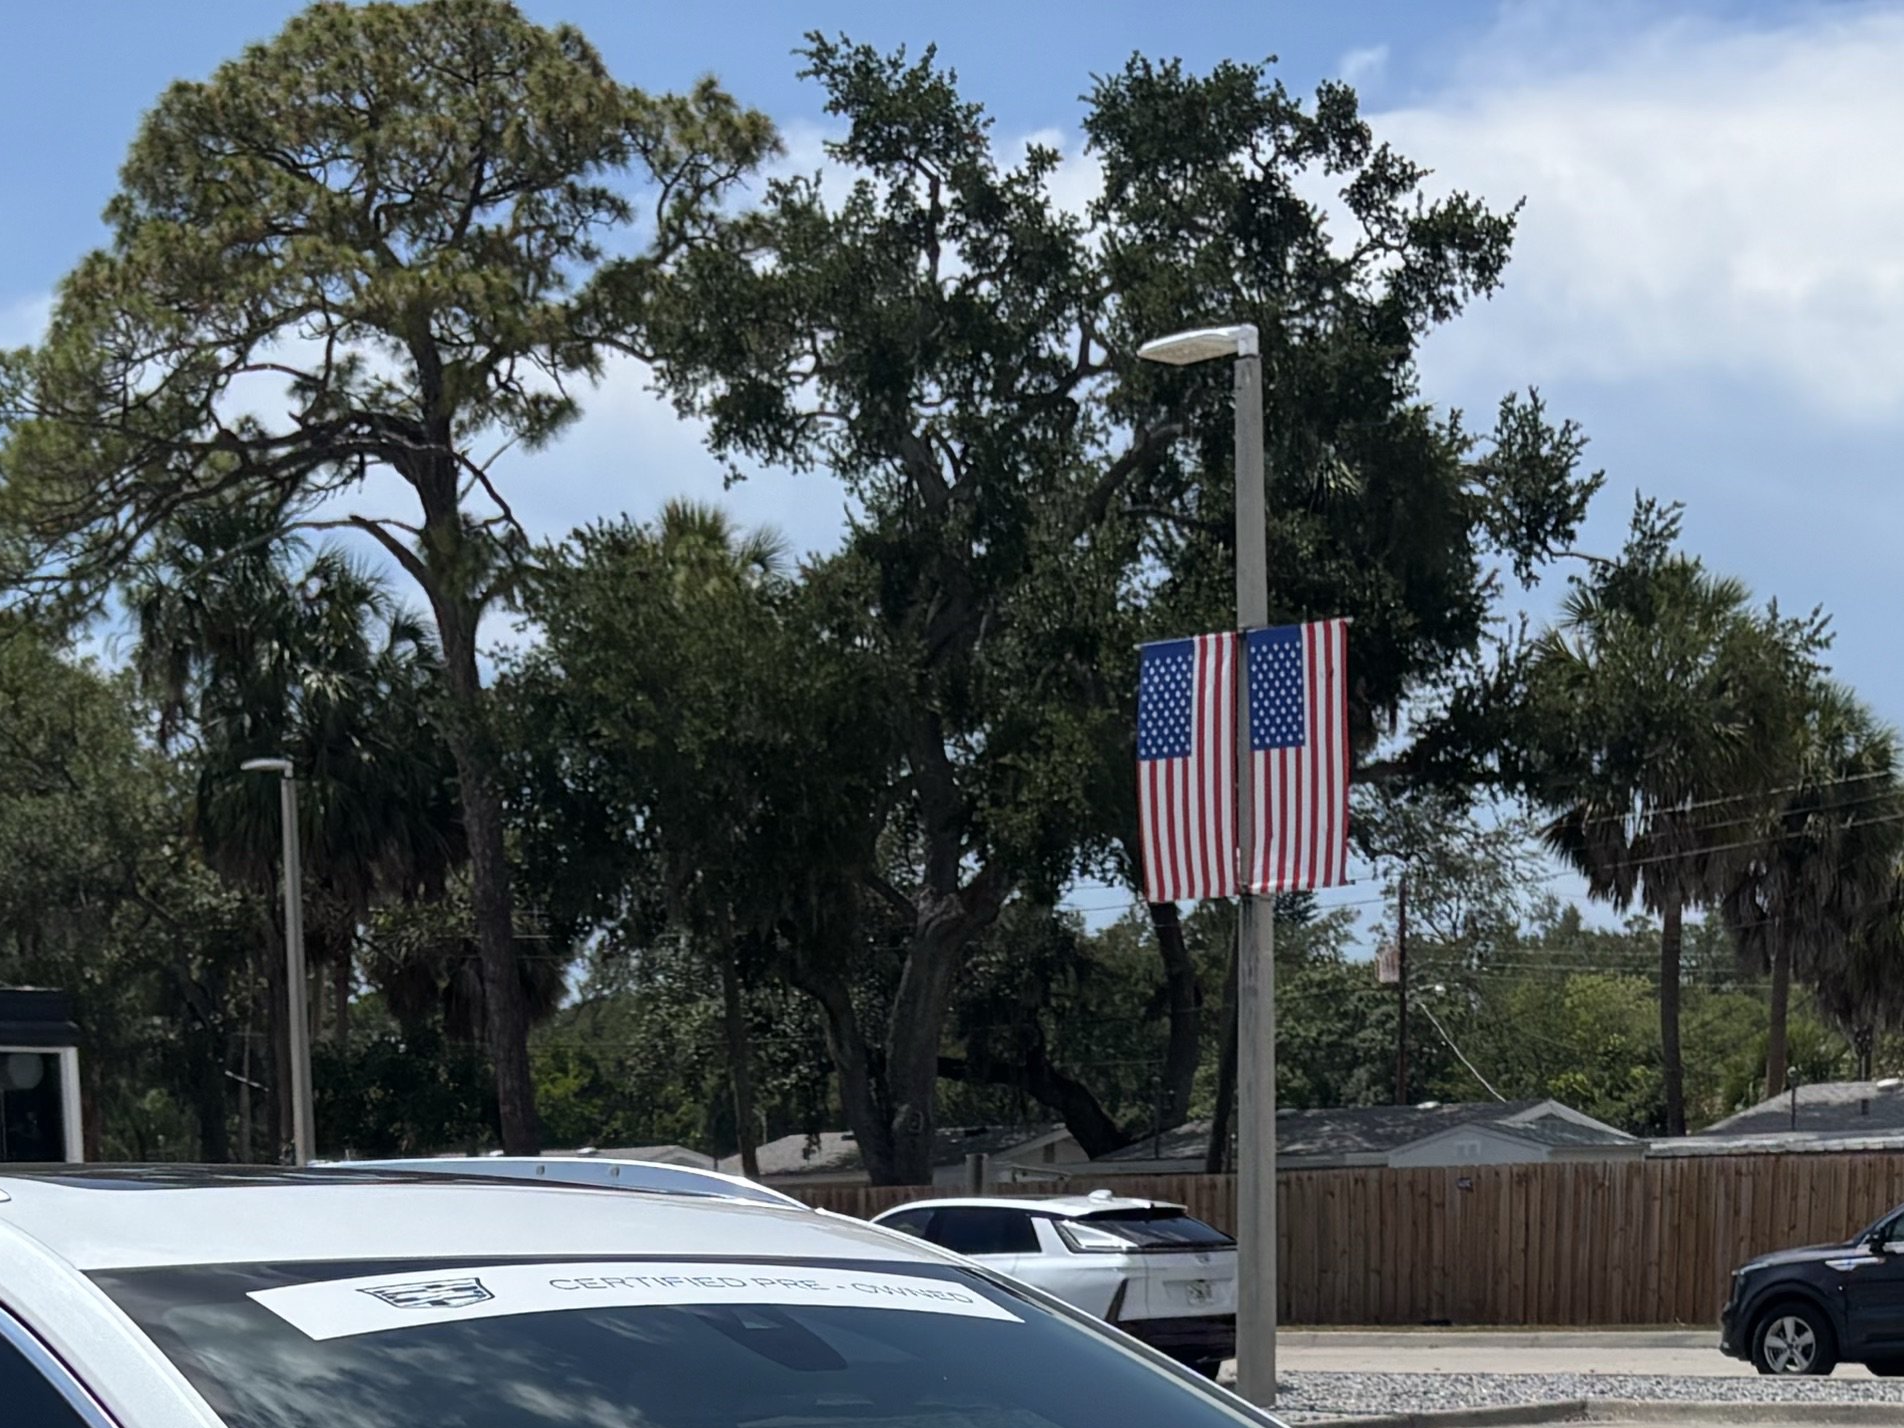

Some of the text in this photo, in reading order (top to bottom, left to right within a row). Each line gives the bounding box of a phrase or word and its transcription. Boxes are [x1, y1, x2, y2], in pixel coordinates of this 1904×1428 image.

[549, 1277, 747, 1291] CERTIFIED
[751, 1277, 824, 1289] PRE
[851, 1282, 974, 1304] OWNED
